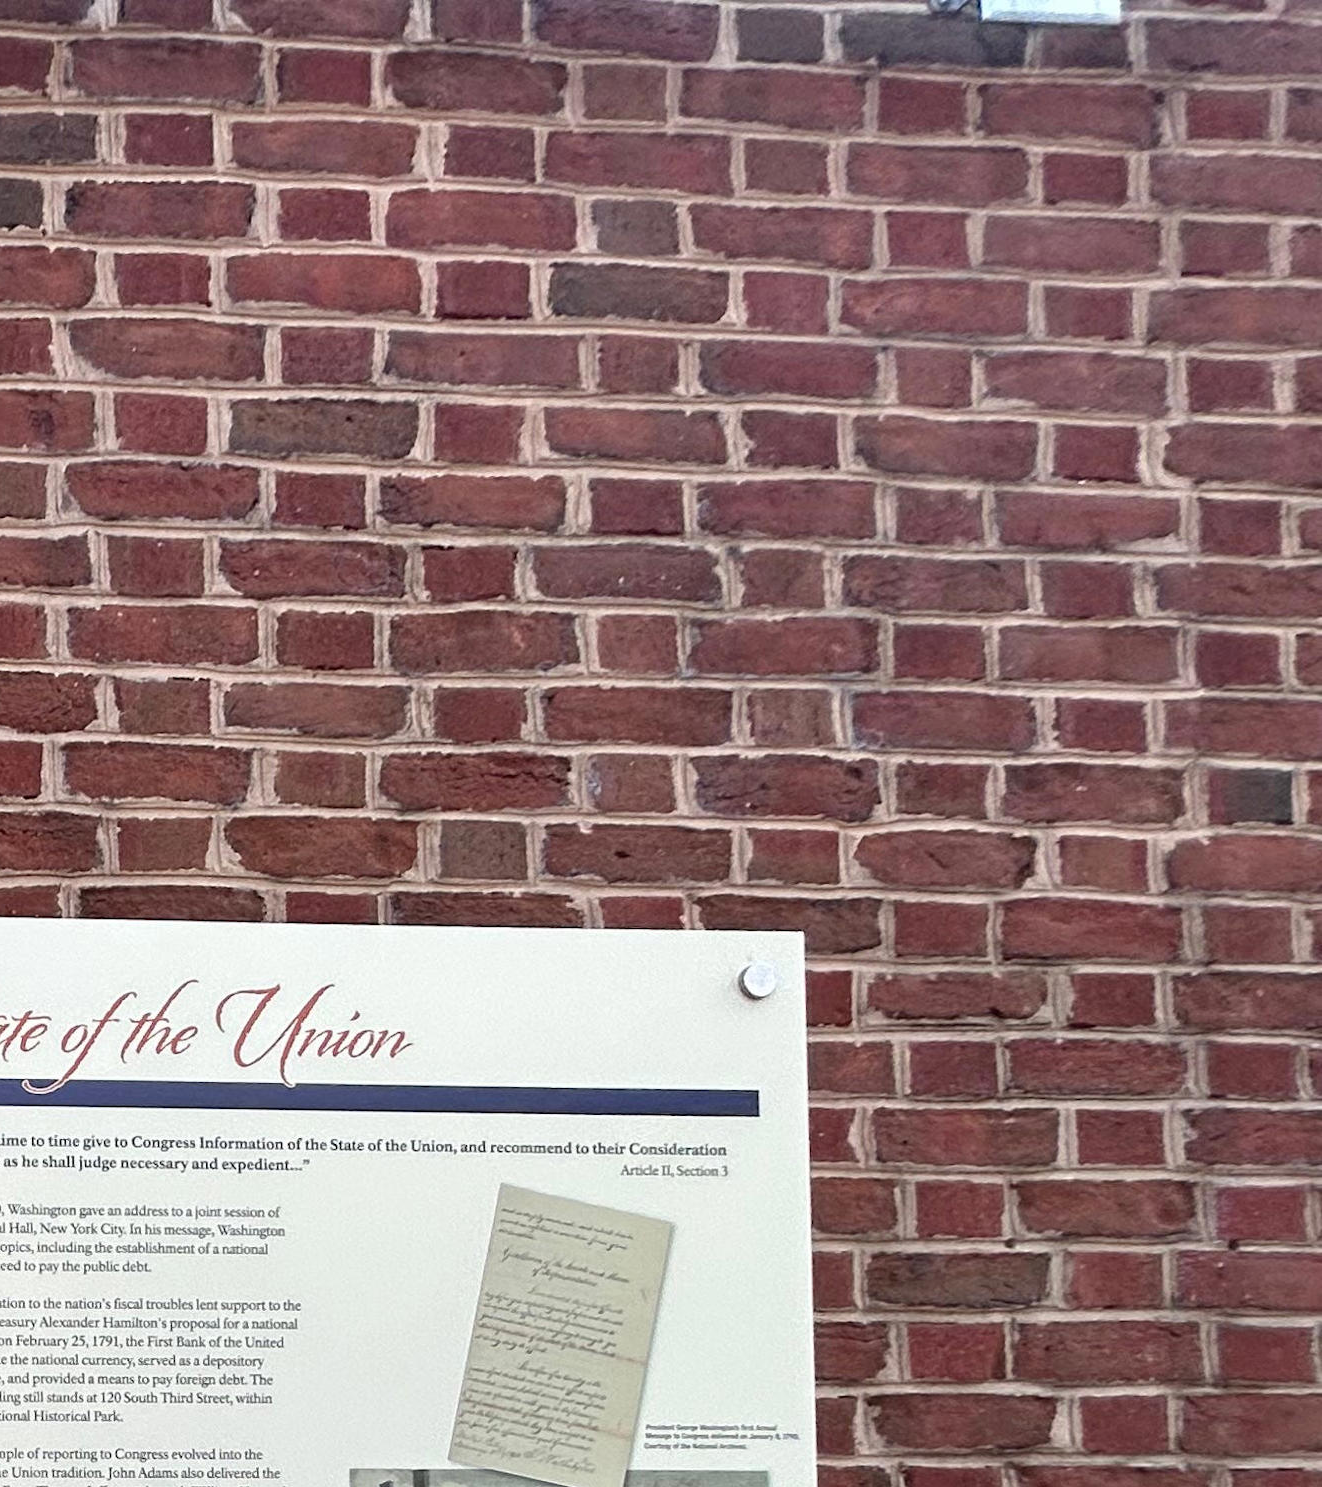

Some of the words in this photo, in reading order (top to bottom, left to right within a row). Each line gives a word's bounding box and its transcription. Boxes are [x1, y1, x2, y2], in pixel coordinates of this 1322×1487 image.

[21, 992, 137, 1095] of
[119, 979, 200, 1063] the
[215, 984, 415, 1088] Union
[31, 1136, 45, 1147] to
[48, 1134, 80, 1148] time
[83, 1135, 111, 1151] give
[114, 1137, 128, 1148] to
[131, 1135, 196, 1152] Congress
[200, 1136, 284, 1150] Information
[287, 1137, 303, 1151] of
[305, 1138, 327, 1151] the
[330, 1138, 365, 1151] State
[367, 1138, 383, 1152] of
[385, 1139, 407, 1152] the
[410, 1139, 458, 1155] Union,
[460, 1140, 487, 1153] and
[490, 1141, 572, 1154] recommend
[575, 1143, 589, 1155] to
[592, 1142, 626, 1155] their
[629, 1142, 727, 1156] Consideration
[3, 1158, 18, 1168] as
[21, 1155, 39, 1168] he
[42, 1155, 76, 1168] shall
[79, 1155, 117, 1172] judge
[120, 1160, 189, 1173] necessary
[191, 1157, 218, 1170] and
[620, 1164, 659, 1176] Article
[661, 1164, 675, 1178] II,
[676, 1165, 719, 1177] Section
[721, 1165, 729, 1177] 3
[33, 1410, 91, 1422] Historical
[94, 1410, 124, 1422] Park.
